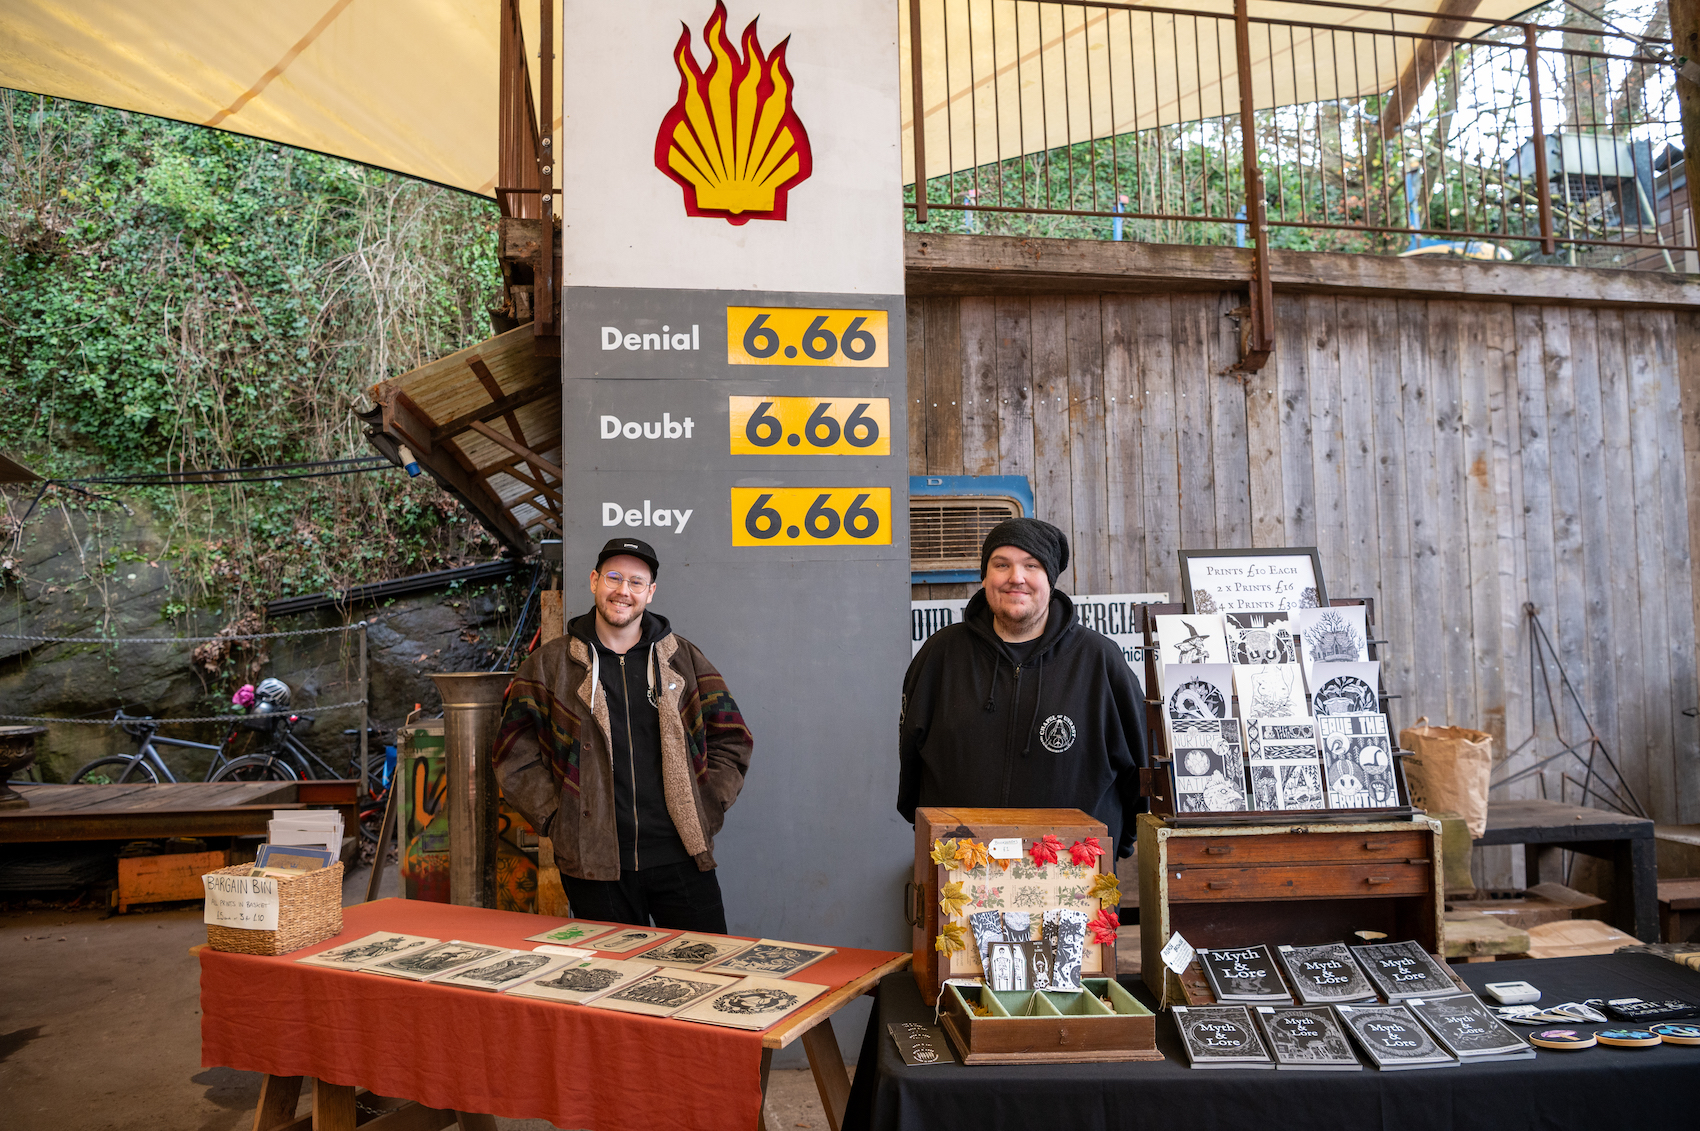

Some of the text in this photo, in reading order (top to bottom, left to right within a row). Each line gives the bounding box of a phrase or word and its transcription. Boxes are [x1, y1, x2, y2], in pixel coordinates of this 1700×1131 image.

[601, 314, 876, 361] Denial 6.66
[600, 402, 880, 448] Doubt 6.66
[927, 478, 943, 486] D
[602, 493, 880, 540] Delay 6.66
[1246, 564, 1266, 577] £10
[1275, 580, 1294, 594] £16
[1219, 603, 1225, 611] 4
[1278, 597, 1297, 611] £30
[1321, 716, 1386, 736] SAVE THE
[208, 876, 272, 894] BARGAIN BIN
[1212, 949, 1260, 962] Myth
[1234, 962, 1250, 971] &
[1304, 959, 1343, 971] Myth
[1379, 957, 1416, 969] Myth
[1221, 968, 1266, 979] Lore
[1322, 969, 1335, 979] &
[1399, 967, 1411, 975] &
[1313, 975, 1349, 985] Lore
[1392, 972, 1426, 982] Lore
[1285, 1017, 1314, 1027] Myth
[1447, 1015, 1475, 1025] Myth
[1201, 1023, 1236, 1034] Myth
[1297, 1024, 1308, 1032] &
[1368, 1023, 1406, 1035] Myth
[1458, 1027, 1485, 1035] Lore
[1462, 1022, 1473, 1030] &
[1215, 1031, 1228, 1040] &
[1291, 1029, 1318, 1037] Lore
[1388, 1031, 1401, 1041] &
[1206, 1038, 1241, 1047] Lore
[1382, 1038, 1416, 1048] Lore
